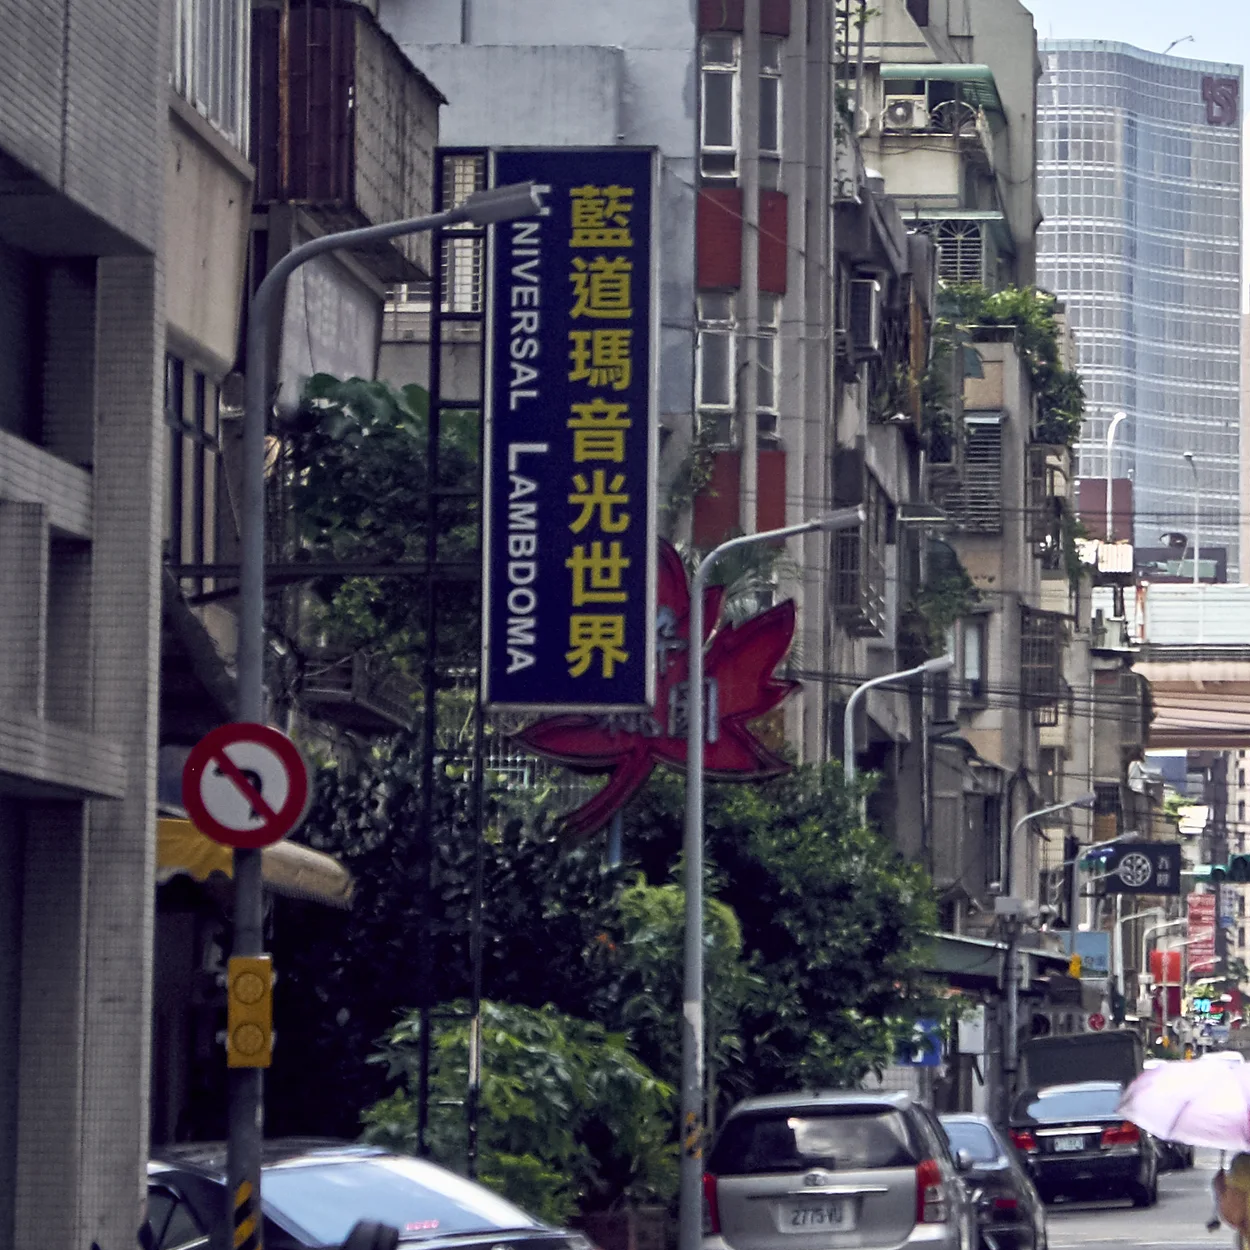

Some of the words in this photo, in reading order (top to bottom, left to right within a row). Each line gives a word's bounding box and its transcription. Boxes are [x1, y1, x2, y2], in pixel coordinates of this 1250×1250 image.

[506, 441, 548, 674] LAMBDOMA
[565, 184, 634, 679] 藍道瑪音光世界
